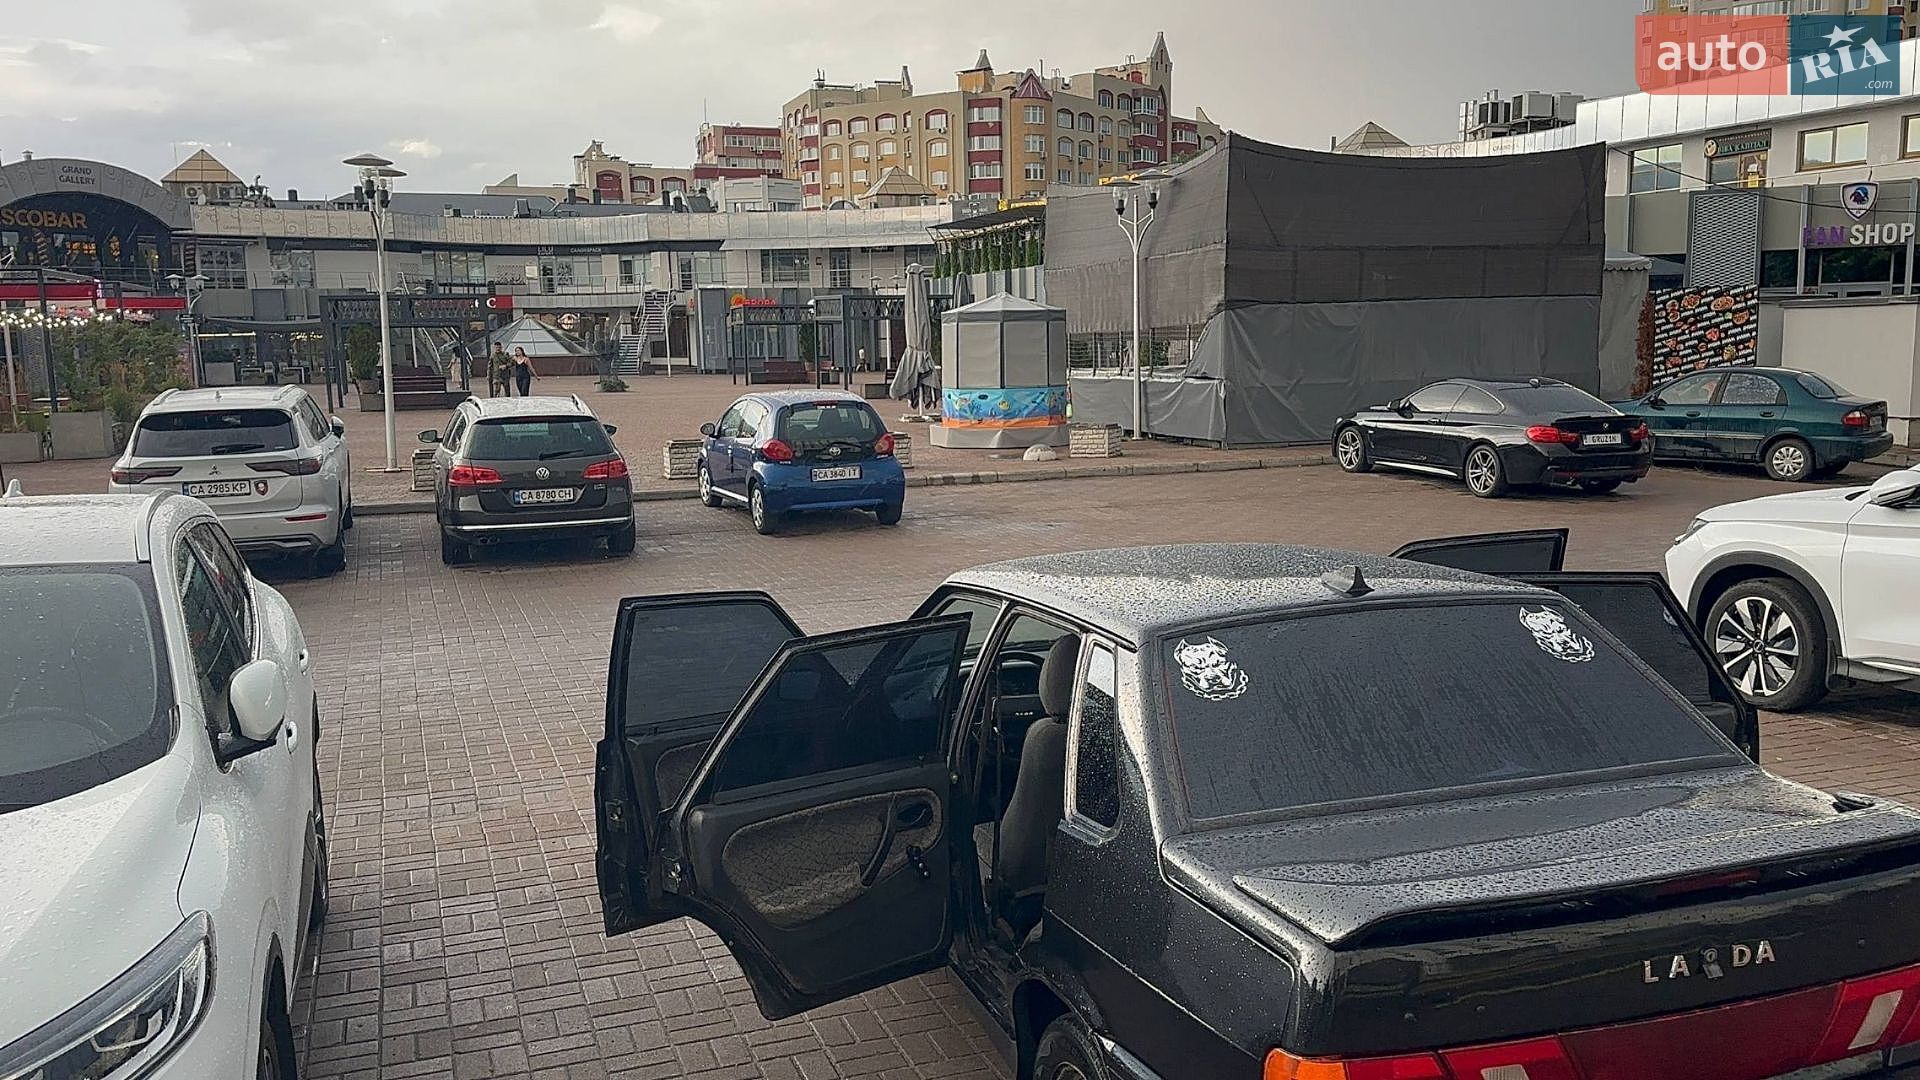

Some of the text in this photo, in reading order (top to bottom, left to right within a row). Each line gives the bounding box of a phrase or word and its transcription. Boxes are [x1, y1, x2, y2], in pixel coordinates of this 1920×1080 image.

[61, 165, 92, 175] GRAND
[59, 175, 95, 185] GALLERY
[1803, 222, 1914, 247] FAN SHOP
[190, 483, 247, 495] CA 2985 KP
[520, 492, 534, 501] CA
[558, 489, 571, 498] CH
[1643, 940, 1776, 984] LADA
